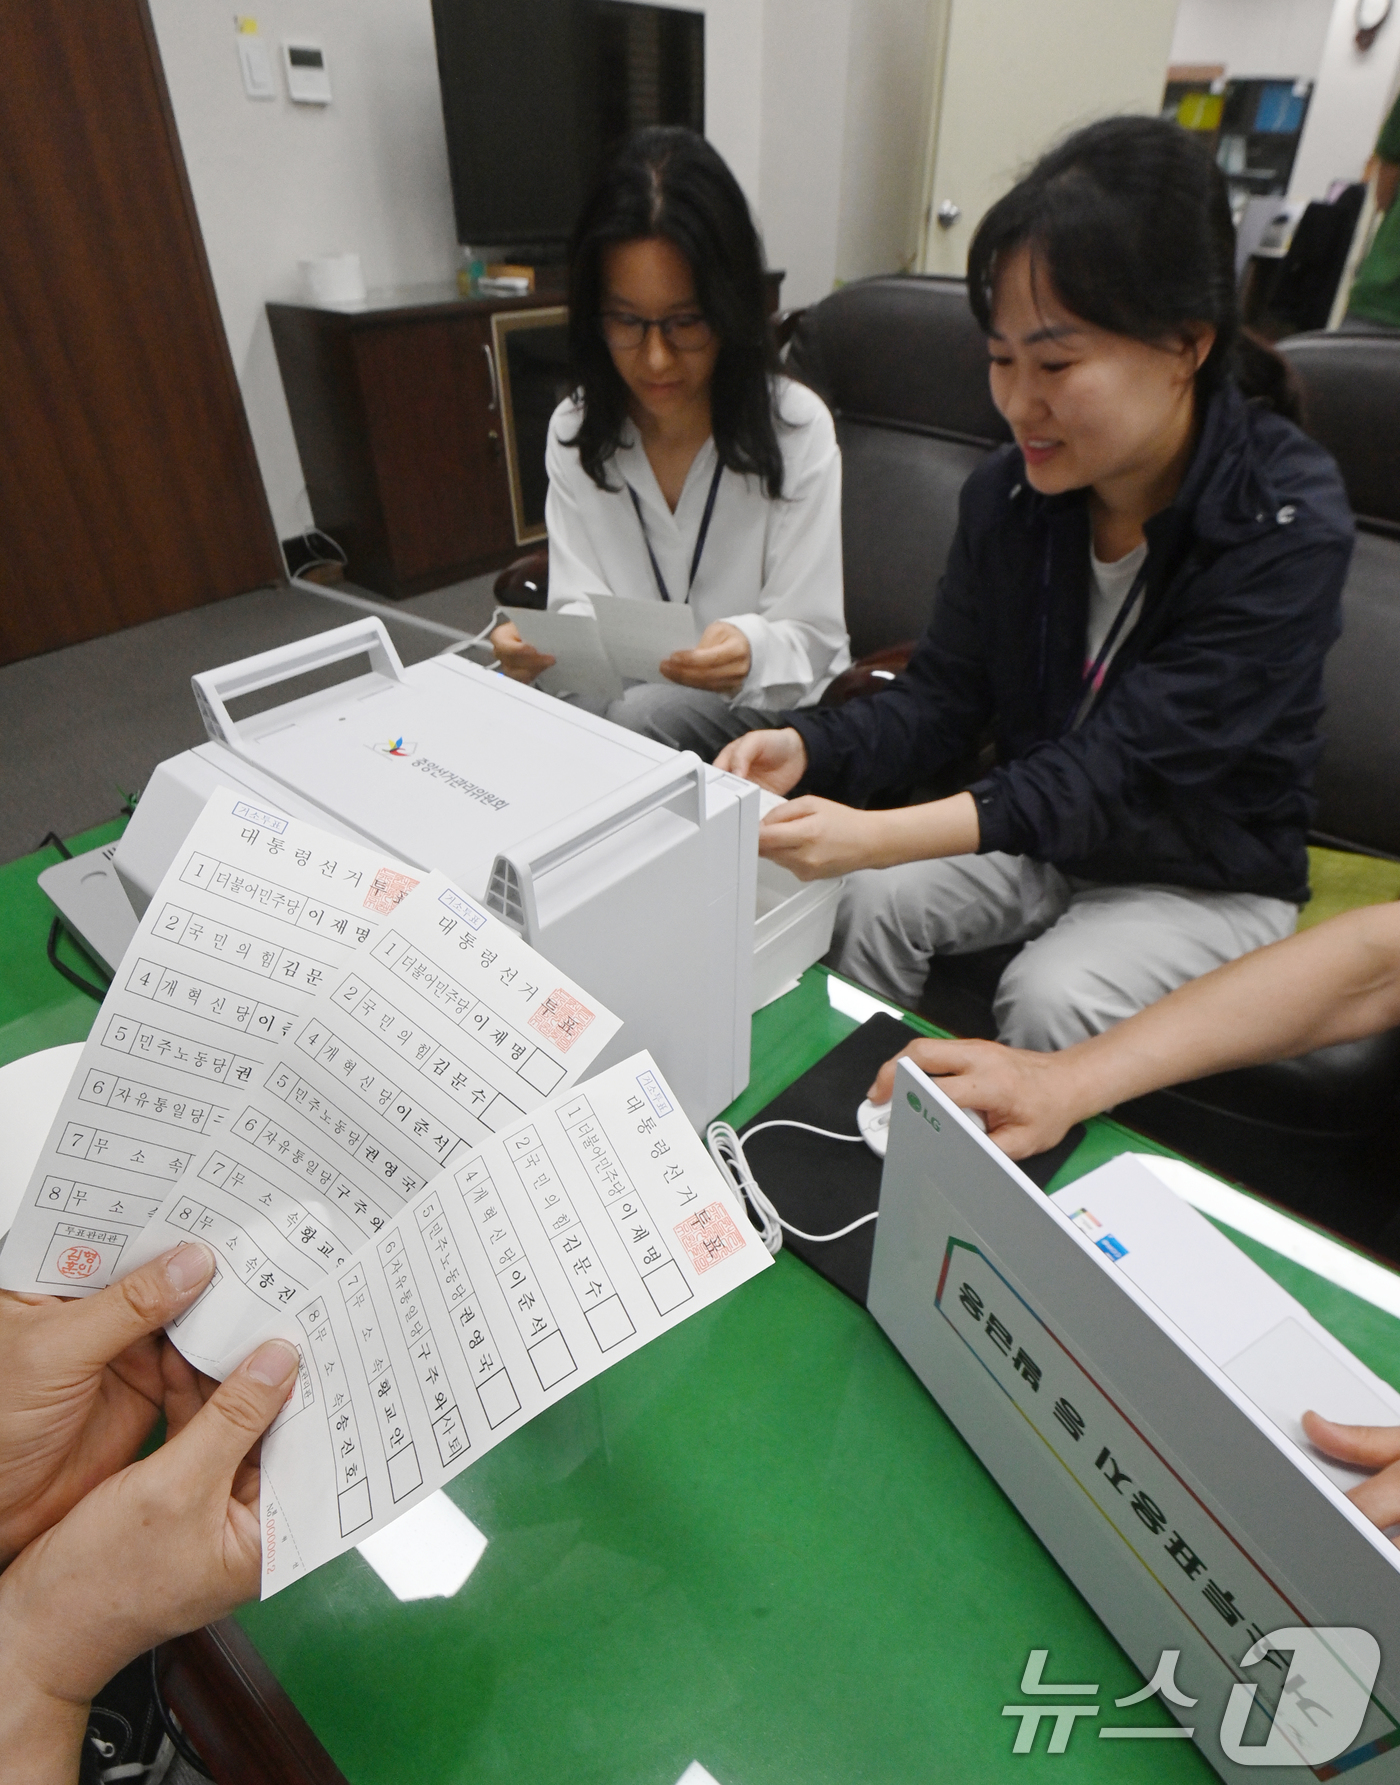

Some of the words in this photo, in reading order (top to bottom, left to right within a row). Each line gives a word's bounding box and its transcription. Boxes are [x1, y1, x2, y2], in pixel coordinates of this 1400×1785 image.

[411, 757, 510, 812] 중앙선거관리위원회
[194, 863, 205, 878] 1
[216, 872, 300, 916] 더불어민주당
[308, 909, 371, 944] 이재명
[139, 971, 151, 987] 4
[164, 915, 180, 931] 2
[282, 960, 323, 987] 김문
[384, 942, 397, 956] 1
[401, 955, 470, 1015] 더불어민주당
[473, 1014, 527, 1061] 이재명
[114, 1025, 128, 1042] 5
[139, 1034, 227, 1074] 민주노동당
[235, 1065, 253, 1083] 권
[343, 986, 359, 1001] 2
[432, 1057, 487, 1105] 김문수
[92, 1080, 106, 1095] 6
[114, 1087, 205, 1125] 자유통일당
[276, 1074, 290, 1088] 5
[295, 1087, 361, 1146] 민주노동당
[365, 1145, 417, 1193] 권영국
[308, 1033, 320, 1046] 4
[396, 1105, 450, 1154] 이준석
[923, 1108, 941, 1133] LG
[71, 1132, 85, 1147] 7
[212, 1161, 226, 1175] 7
[244, 1118, 258, 1132] 6
[262, 1130, 332, 1185] 자유통일당
[336, 1183, 385, 1234] 구주와
[48, 1186, 62, 1201] 8
[422, 1204, 435, 1218] 5
[515, 1136, 531, 1150] 2
[562, 1234, 603, 1298] 김문수
[567, 1106, 581, 1118] 1
[578, 1122, 626, 1197] 더불어민주당
[620, 1202, 662, 1265] 이재명
[65, 1226, 118, 1243] 투표관리관
[178, 1207, 193, 1221] 8
[259, 1272, 297, 1305] 송진
[428, 1222, 467, 1301] 민주노동당
[465, 1171, 479, 1183] 4
[510, 1270, 548, 1337] 이준석
[347, 1274, 359, 1287] 7
[377, 1378, 405, 1449] 황교안
[385, 1241, 396, 1254] 6
[391, 1259, 424, 1338] 자유통일당
[417, 1342, 448, 1412] 구주와
[442, 1416, 463, 1458] 사퇴
[459, 1305, 494, 1374] 권영국
[959, 1282, 1043, 1394] 발급용
[308, 1309, 321, 1323] 8
[335, 1414, 358, 1482] 송진호
[1052, 1397, 1086, 1442] 등
